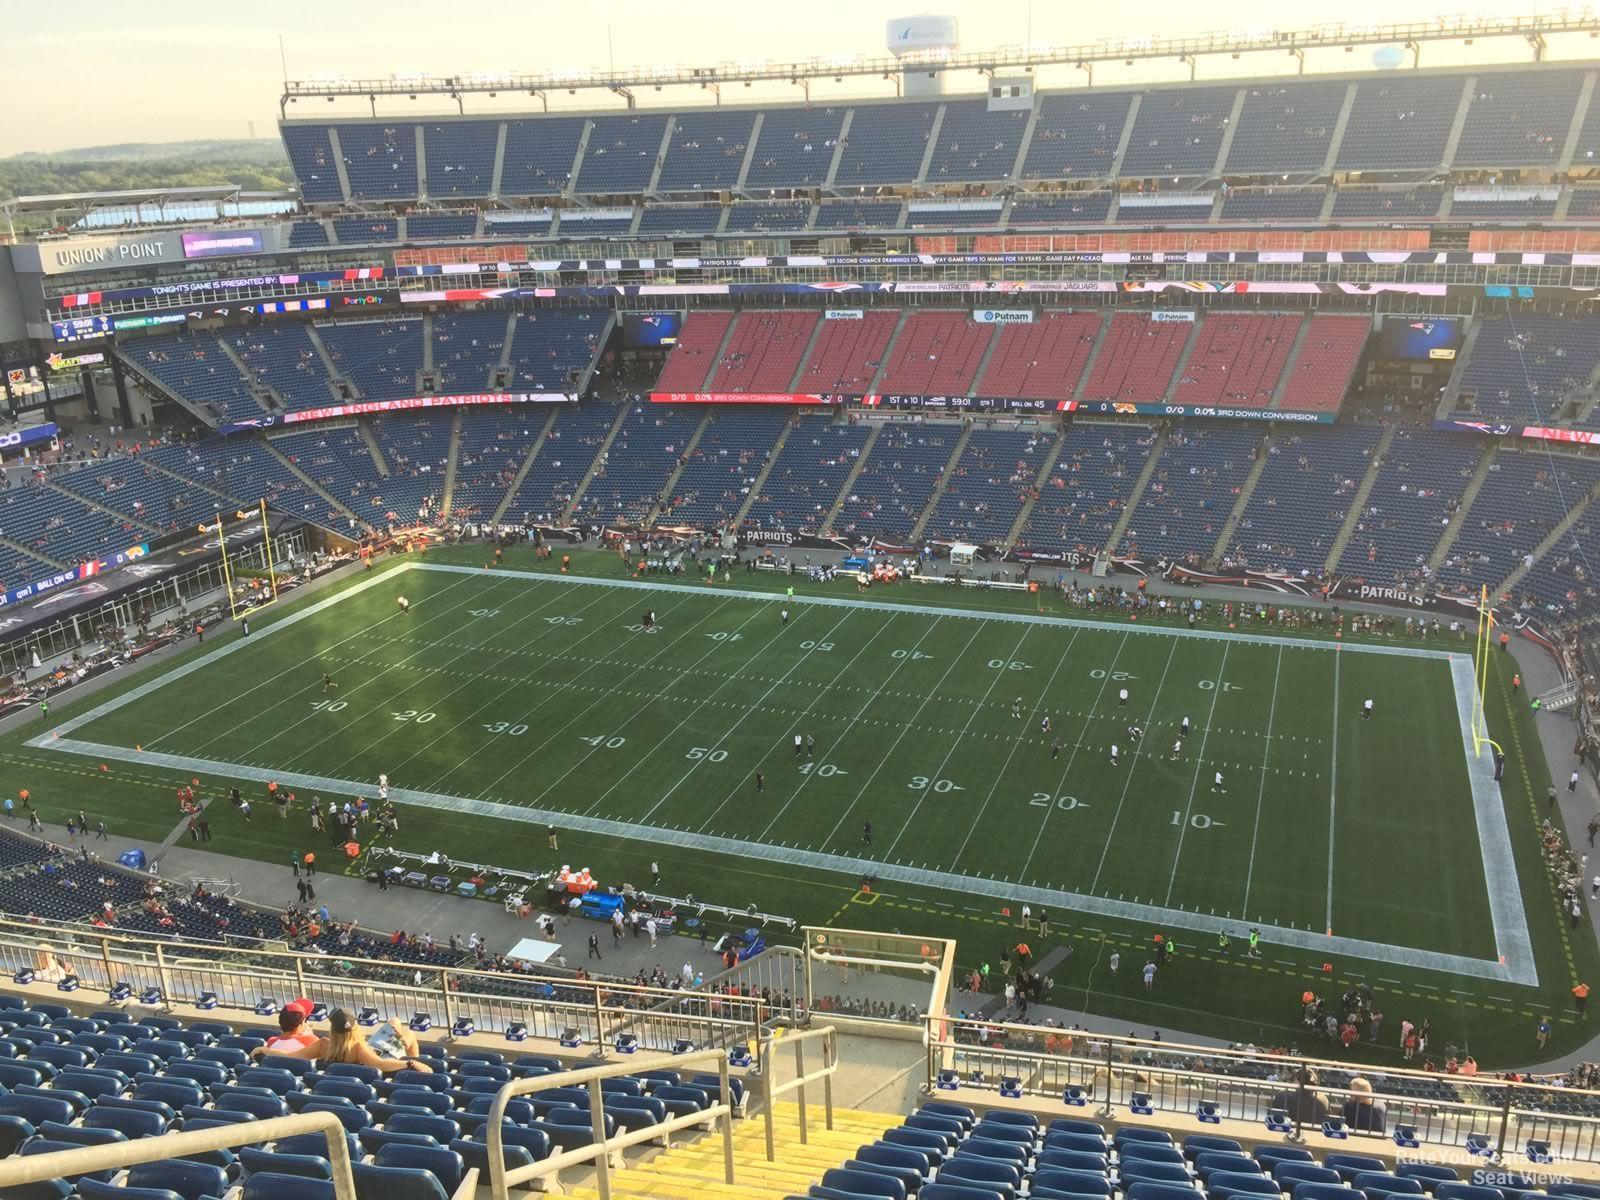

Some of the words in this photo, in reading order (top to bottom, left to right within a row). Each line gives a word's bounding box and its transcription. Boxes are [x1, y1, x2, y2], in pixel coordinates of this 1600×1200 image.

[59, 247, 104, 266] UNION
[120, 242, 164, 259] POINT
[152, 284, 189, 295] TONIGHT'S
[190, 282, 212, 291] GAME
[213, 281, 220, 289] IS
[221, 277, 264, 288] PRESENTED
[265, 277, 278, 285] BY:
[939, 283, 970, 291] PATRIOTS
[836, 311, 858, 319] Putnam
[995, 312, 1029, 321] Putnam
[1164, 312, 1189, 320] Putnam
[695, 393, 712, 401] 0.0%
[952, 398, 971, 406] 59:01
[1035, 401, 1045, 409] 45
[296, 408, 334, 421] NEW
[342, 398, 423, 415] ENGLAND
[431, 393, 512, 405] PATRIOTS
[1100, 403, 1107, 411] 0
[1165, 406, 1184, 414] 0/0
[1194, 407, 1215, 416] 0.0%
[1235, 410, 1261, 418] DOWN
[1262, 411, 1318, 421] CONVERSION
[1541, 428, 1592, 443] NEW
[747, 530, 793, 544] PATRIOTS
[116, 554, 123, 563] 0
[37, 578, 55, 591] BALL
[54, 574, 65, 585] ON
[312, 699, 348, 712] 10
[393, 710, 437, 724] 20
[486, 721, 529, 736] 30
[586, 734, 626, 749] 40
[685, 747, 728, 763] 50
[797, 762, 838, 777] 40
[907, 776, 954, 793] 30
[1028, 792, 1078, 810] 20
[1169, 811, 1213, 829] 10
